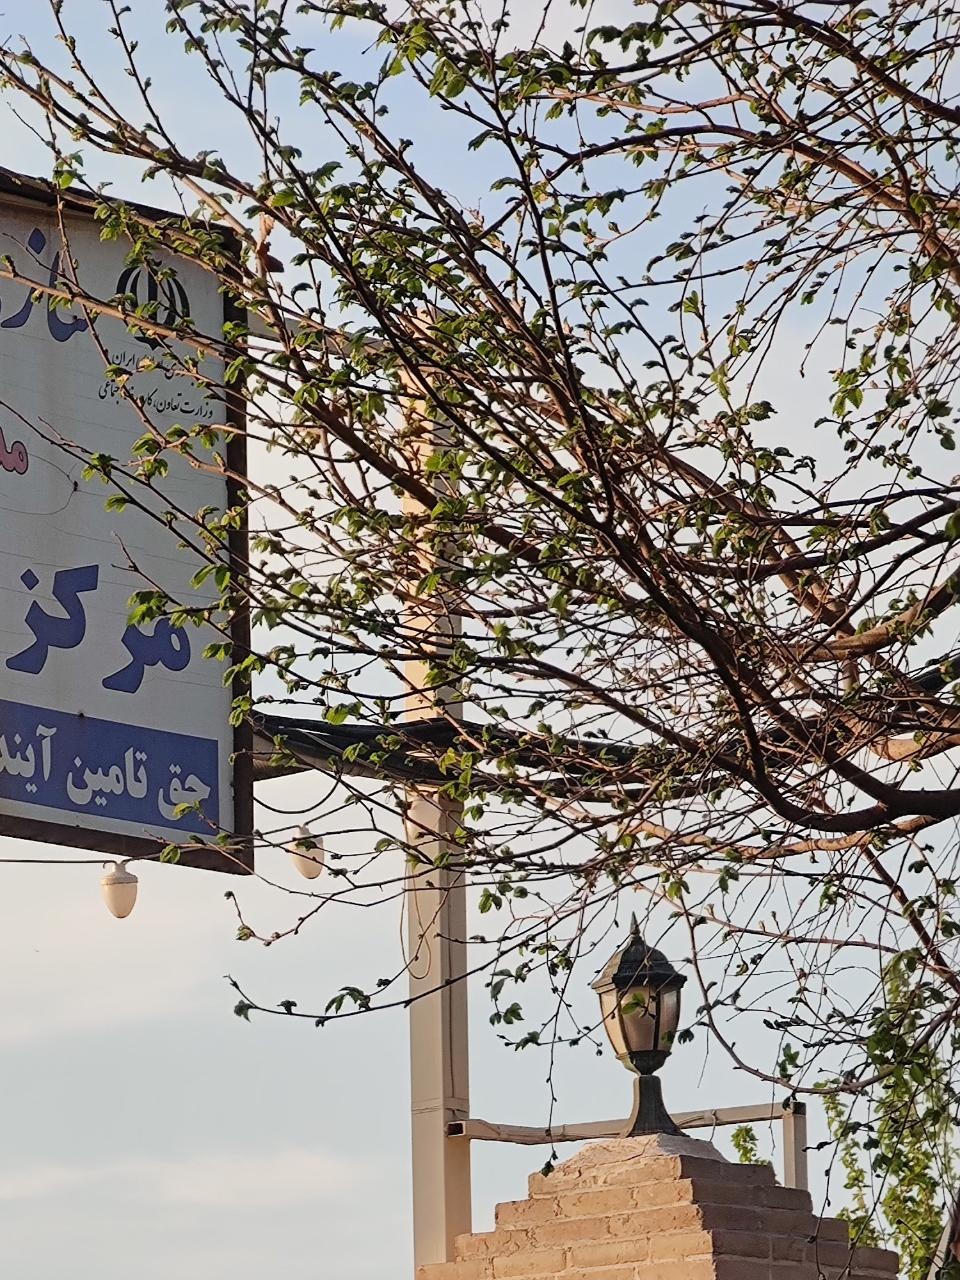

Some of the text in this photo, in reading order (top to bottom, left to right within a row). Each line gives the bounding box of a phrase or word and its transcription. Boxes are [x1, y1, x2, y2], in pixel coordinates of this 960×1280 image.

[180, 400, 214, 419] وزارت
[5, 564, 192, 694] مرکز
[66, 746, 148, 807] تامین
[157, 763, 212, 821] حق
